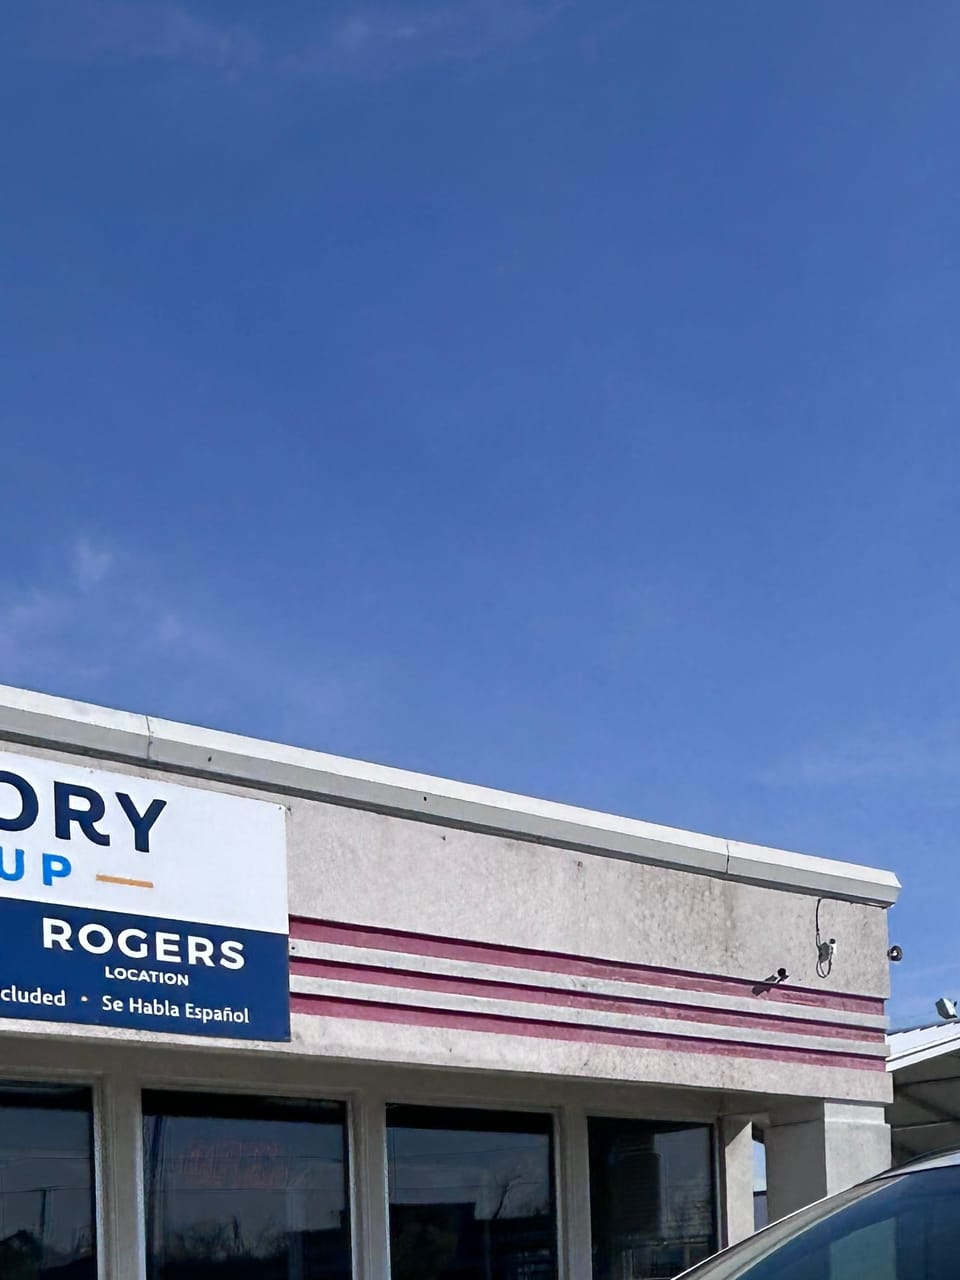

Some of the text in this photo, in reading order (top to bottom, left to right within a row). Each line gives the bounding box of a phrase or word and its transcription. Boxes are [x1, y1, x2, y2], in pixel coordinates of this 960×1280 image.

[42, 917, 246, 970] ROGERS
[105, 966, 189, 987] LOCATION
[102, 995, 249, 1024] Se Habla Español
